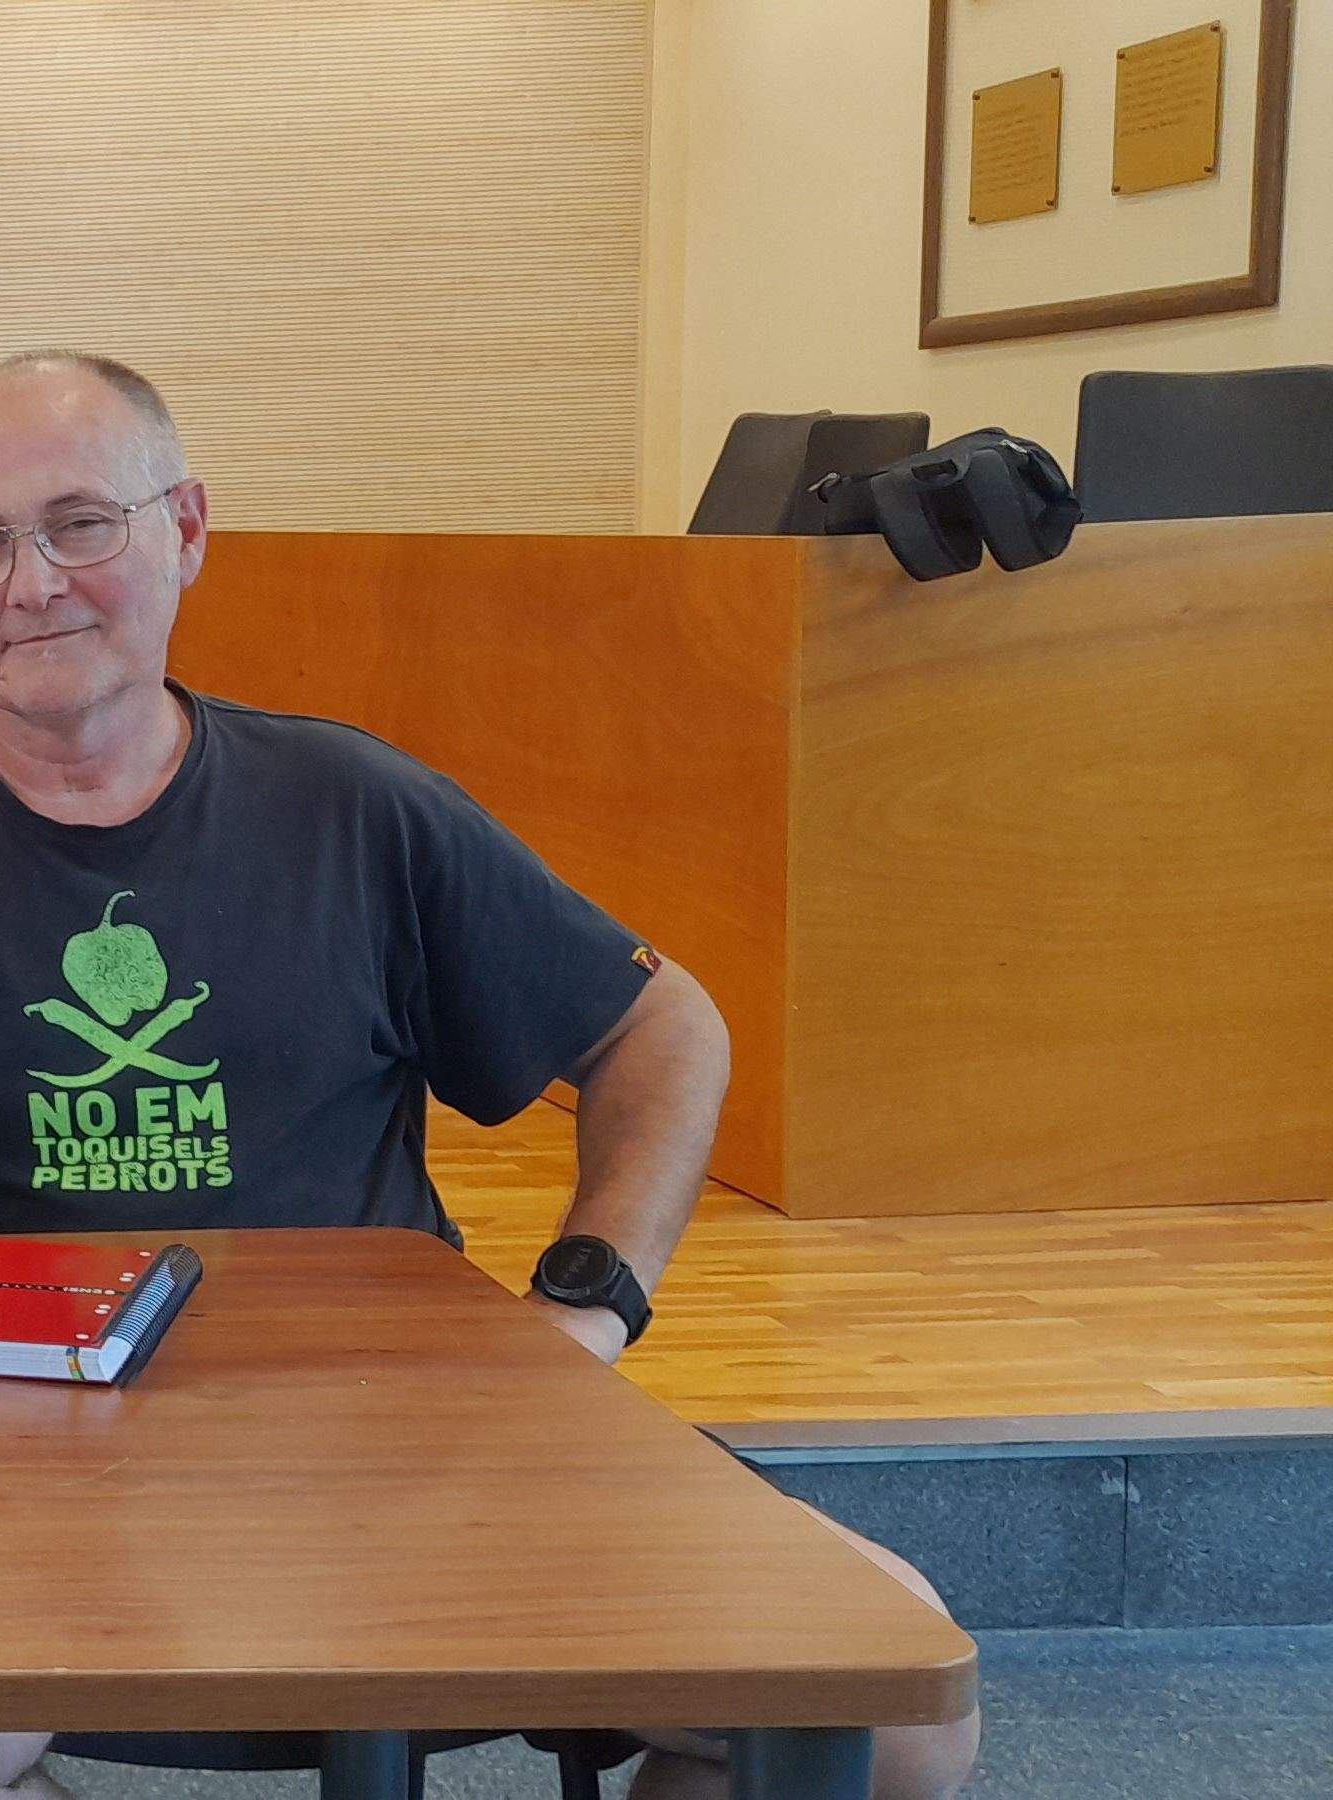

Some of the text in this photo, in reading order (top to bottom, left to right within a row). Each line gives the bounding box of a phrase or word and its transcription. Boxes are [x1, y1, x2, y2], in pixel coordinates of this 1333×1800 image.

[27, 1082, 229, 1137] NO EM
[32, 1135, 230, 1166] TOQUIS ELS
[31, 1156, 234, 1192] PEBROTS
